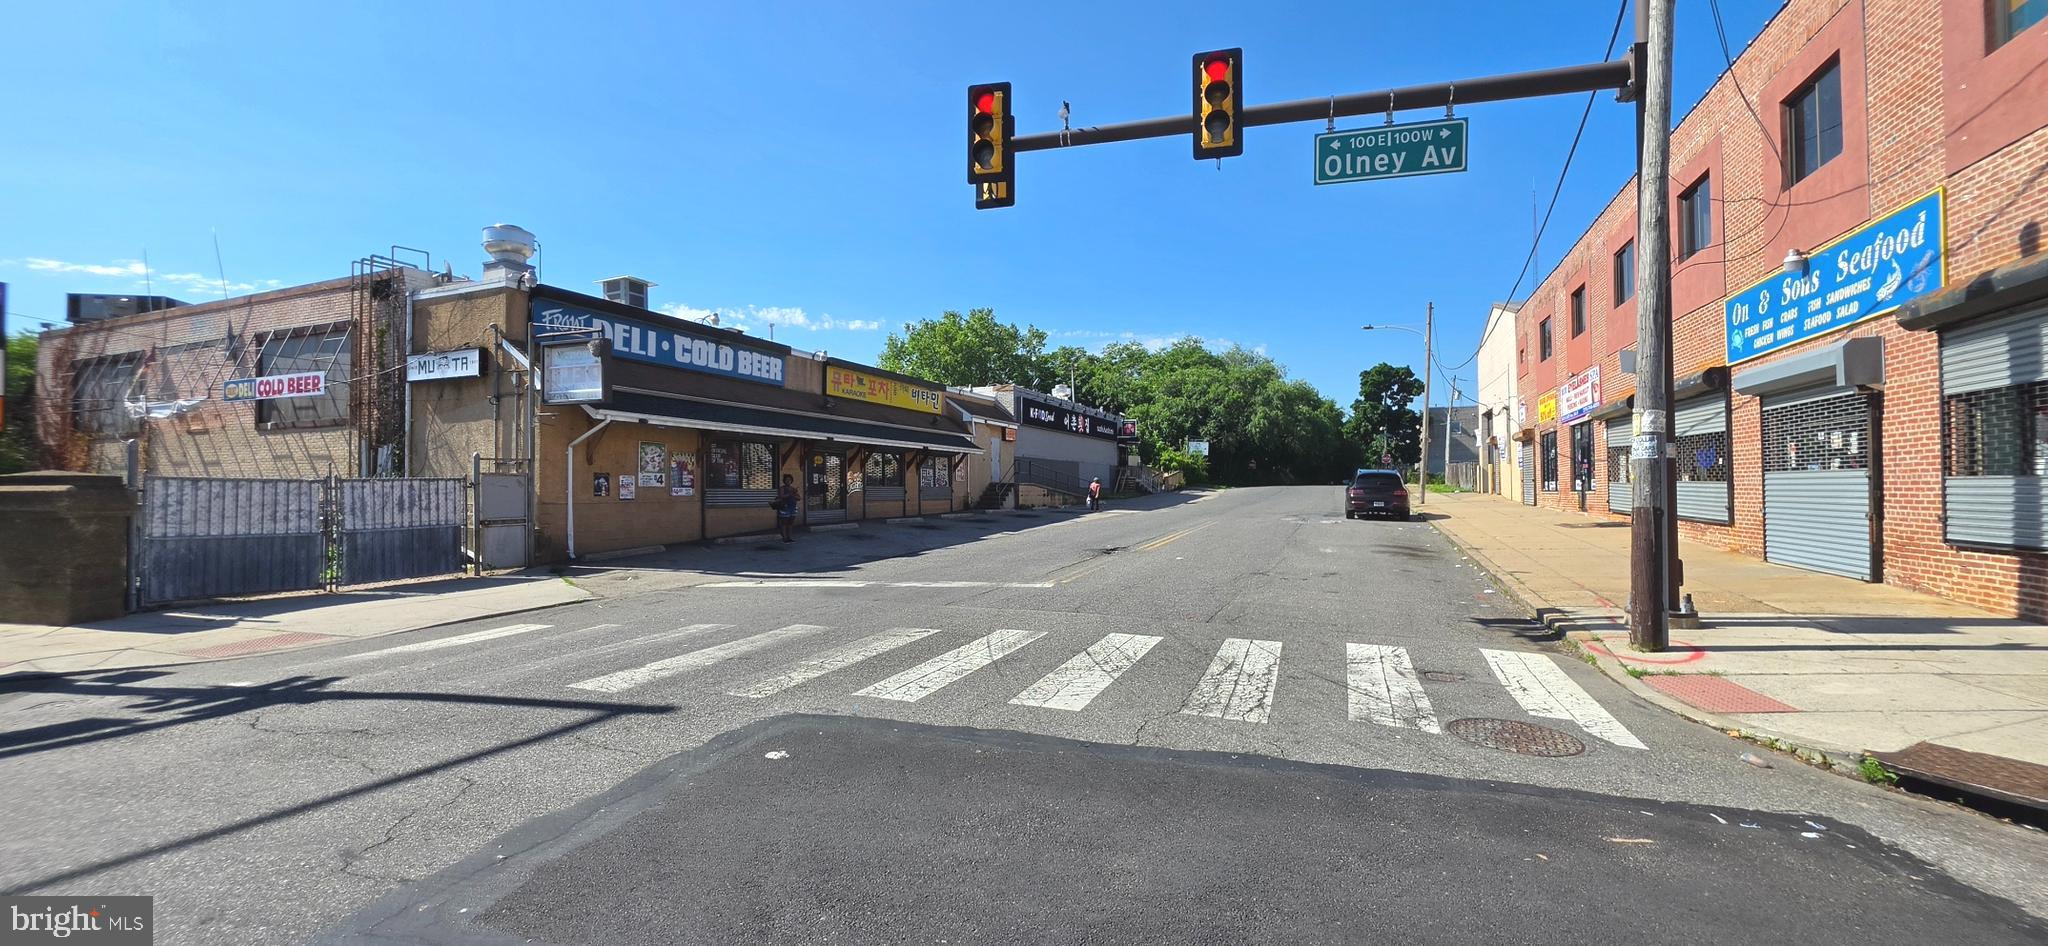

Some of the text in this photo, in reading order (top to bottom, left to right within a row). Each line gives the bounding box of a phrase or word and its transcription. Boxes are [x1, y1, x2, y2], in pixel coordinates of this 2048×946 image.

[1324, 145, 1457, 176] Olney Av
[1732, 210, 1927, 326] On & Sons Seafood
[1744, 276, 1872, 338] FRESH FISH CRABS FISH SANDWICHES
[1753, 301, 1859, 349] CHICKEN WINGS SEAFOOD SALAD
[417, 360, 435, 374] MU
[452, 357, 468, 371] TA
[592, 318, 656, 357] DELI
[673, 333, 733, 371] COLD
[737, 350, 782, 381] BEER
[238, 382, 254, 398] DELI
[257, 379, 285, 397] COLD
[287, 375, 321, 394] BEER
